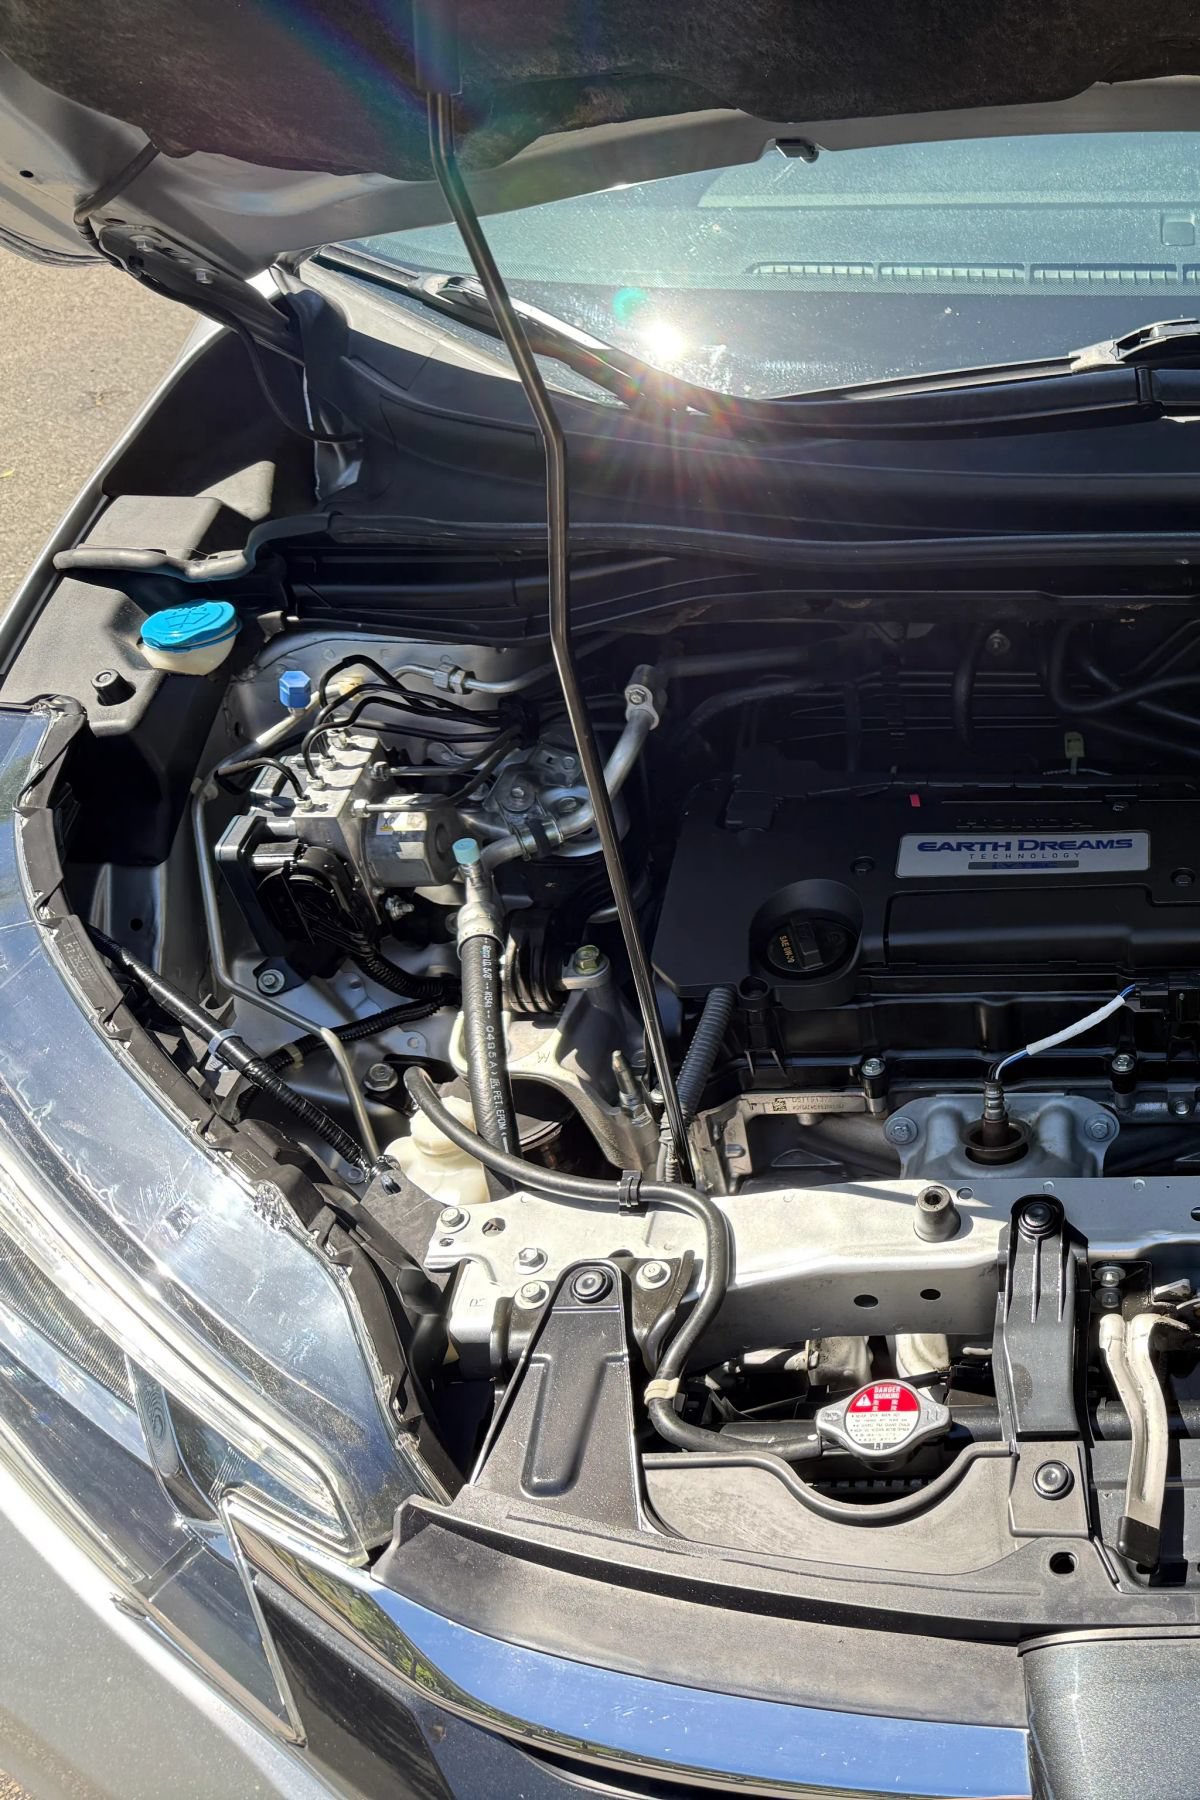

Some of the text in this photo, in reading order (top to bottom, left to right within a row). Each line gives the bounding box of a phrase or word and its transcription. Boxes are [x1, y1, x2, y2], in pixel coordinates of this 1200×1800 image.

[917, 838, 1133, 852] EARTH DREAMS
[969, 852, 1080, 860] TECHNOLOGY
[779, 935, 792, 947] SAE
[484, 991, 493, 1008] R134a
